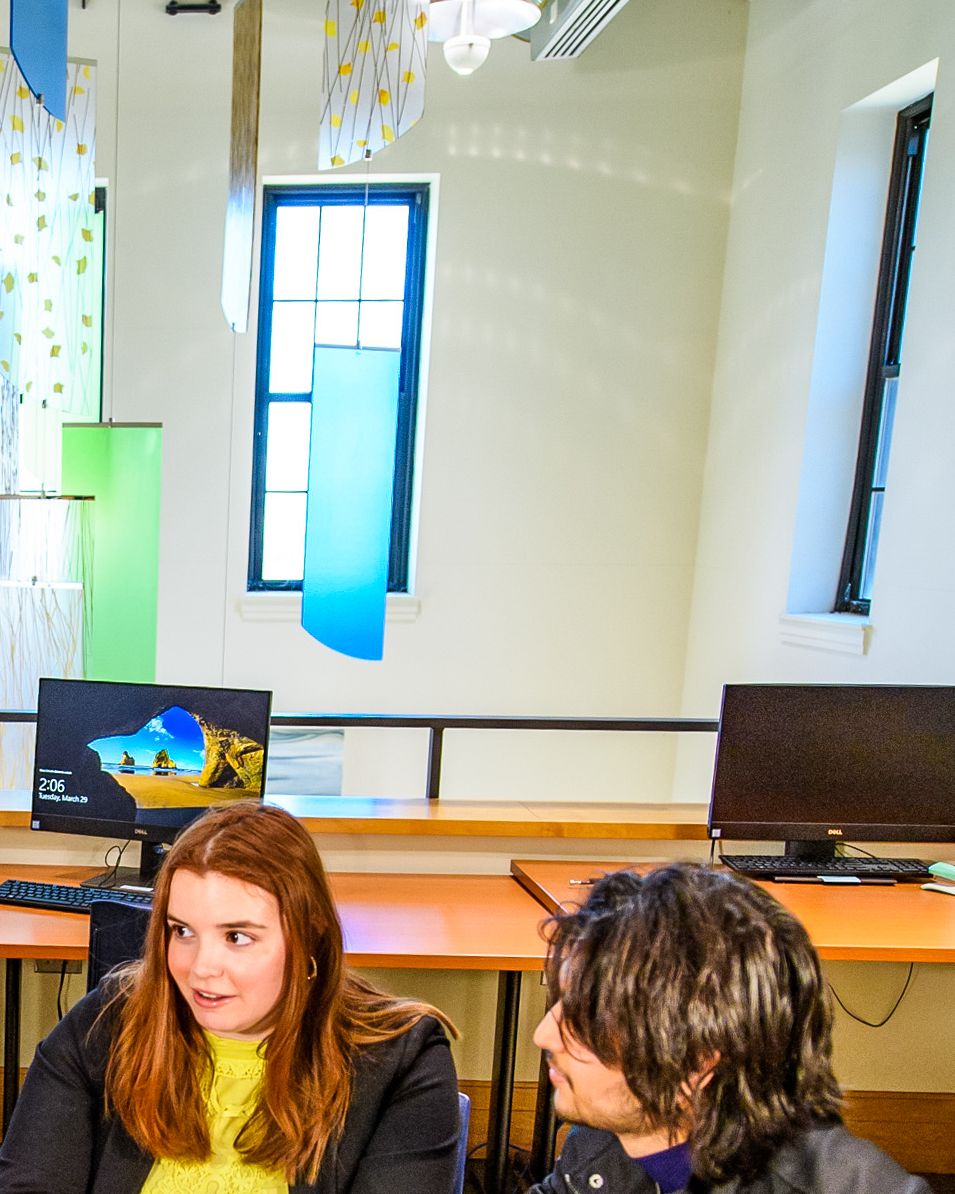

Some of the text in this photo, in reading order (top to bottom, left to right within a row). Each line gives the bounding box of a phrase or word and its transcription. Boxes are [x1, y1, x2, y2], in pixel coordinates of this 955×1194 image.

[39, 777, 65, 792] 2:06
[39, 792, 61, 802] Tuesday,
[62, 794, 79, 802] March
